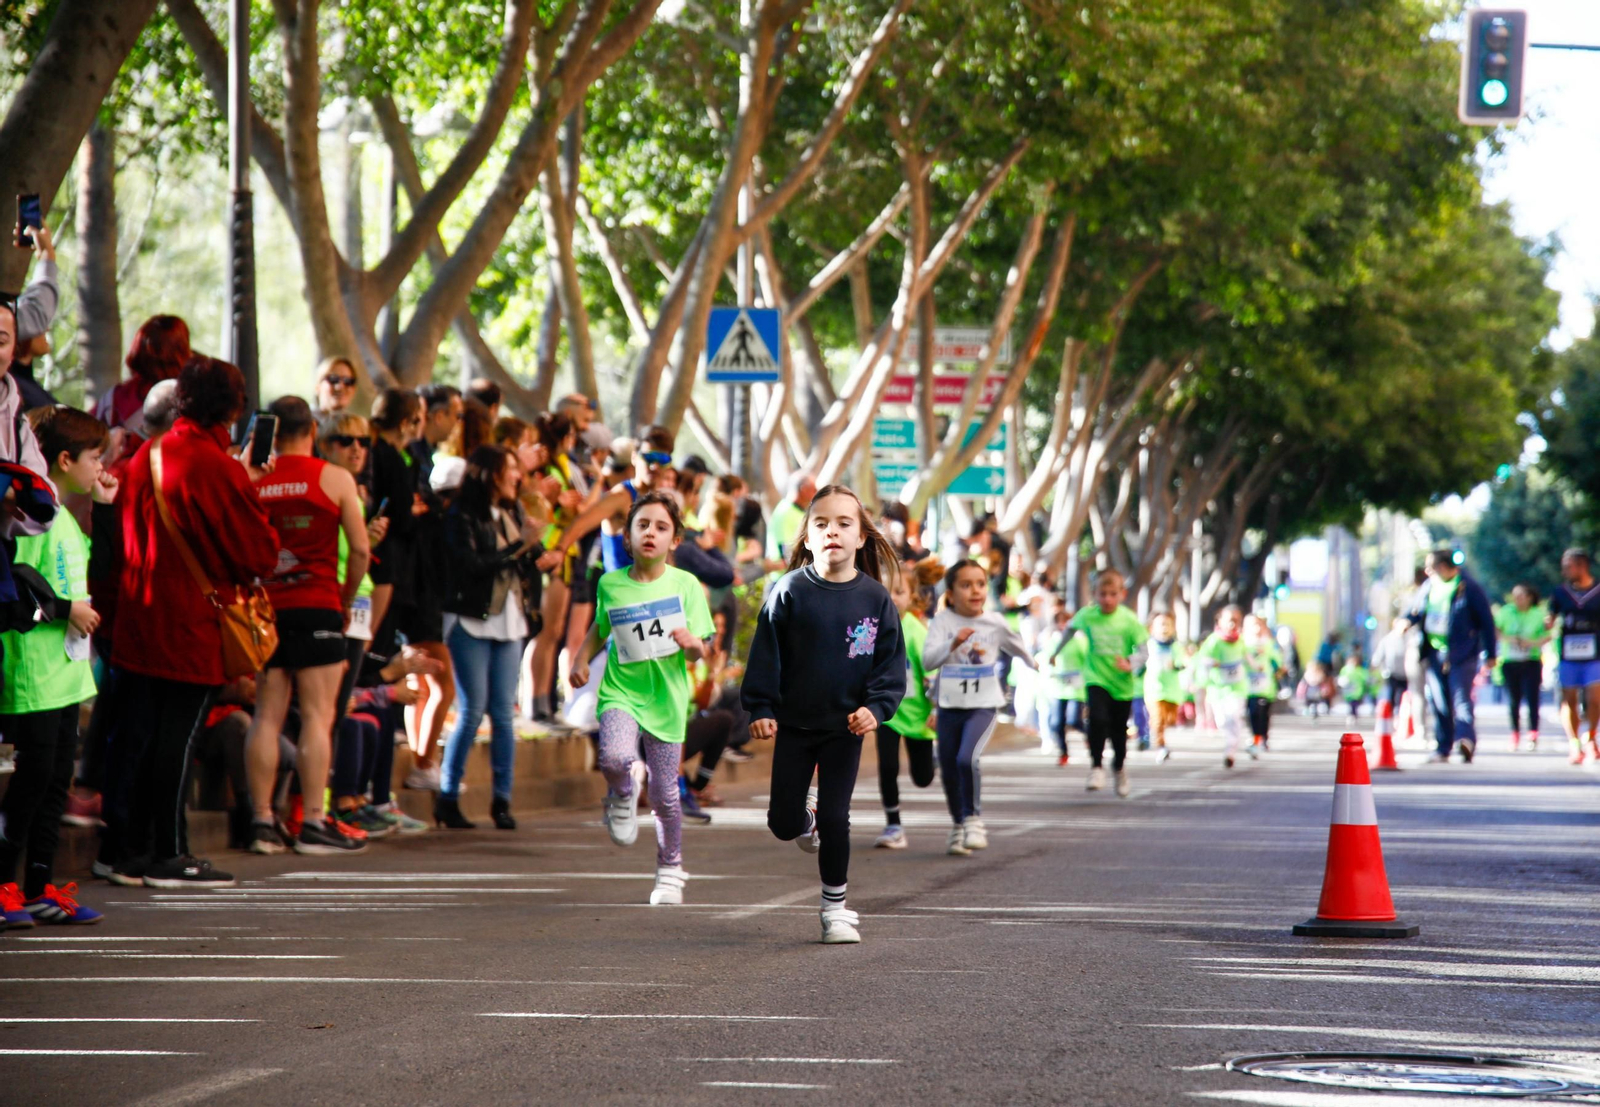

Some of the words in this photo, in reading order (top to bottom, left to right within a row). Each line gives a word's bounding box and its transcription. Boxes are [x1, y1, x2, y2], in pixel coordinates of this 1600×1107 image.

[256, 481, 308, 498] ARRETERO
[632, 618, 664, 642] 14
[959, 679, 980, 694] 11
